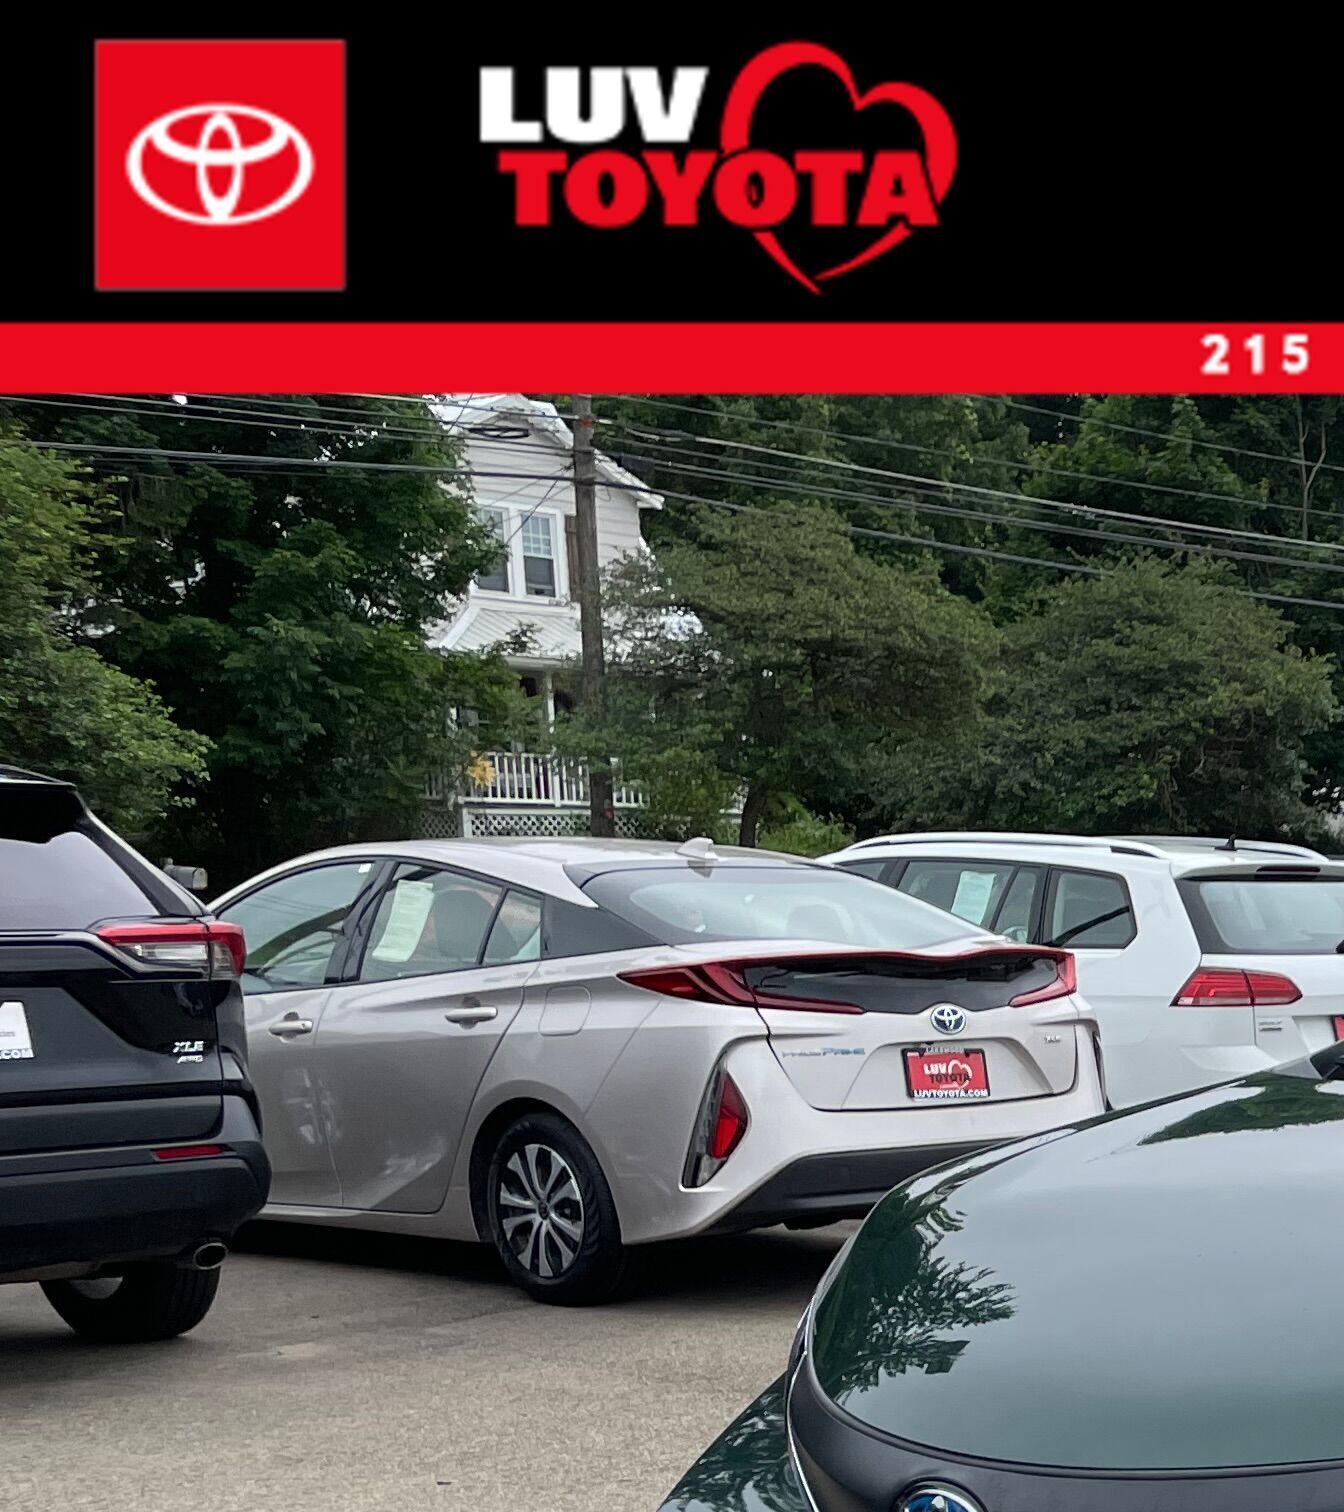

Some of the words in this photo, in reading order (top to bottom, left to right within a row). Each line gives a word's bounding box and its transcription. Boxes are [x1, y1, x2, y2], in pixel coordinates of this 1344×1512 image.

[924, 1063, 947, 1075] LUV
[929, 1073, 969, 1083] TOYOTA
[914, 1089, 988, 1098] LUVTOYOTA.COM
